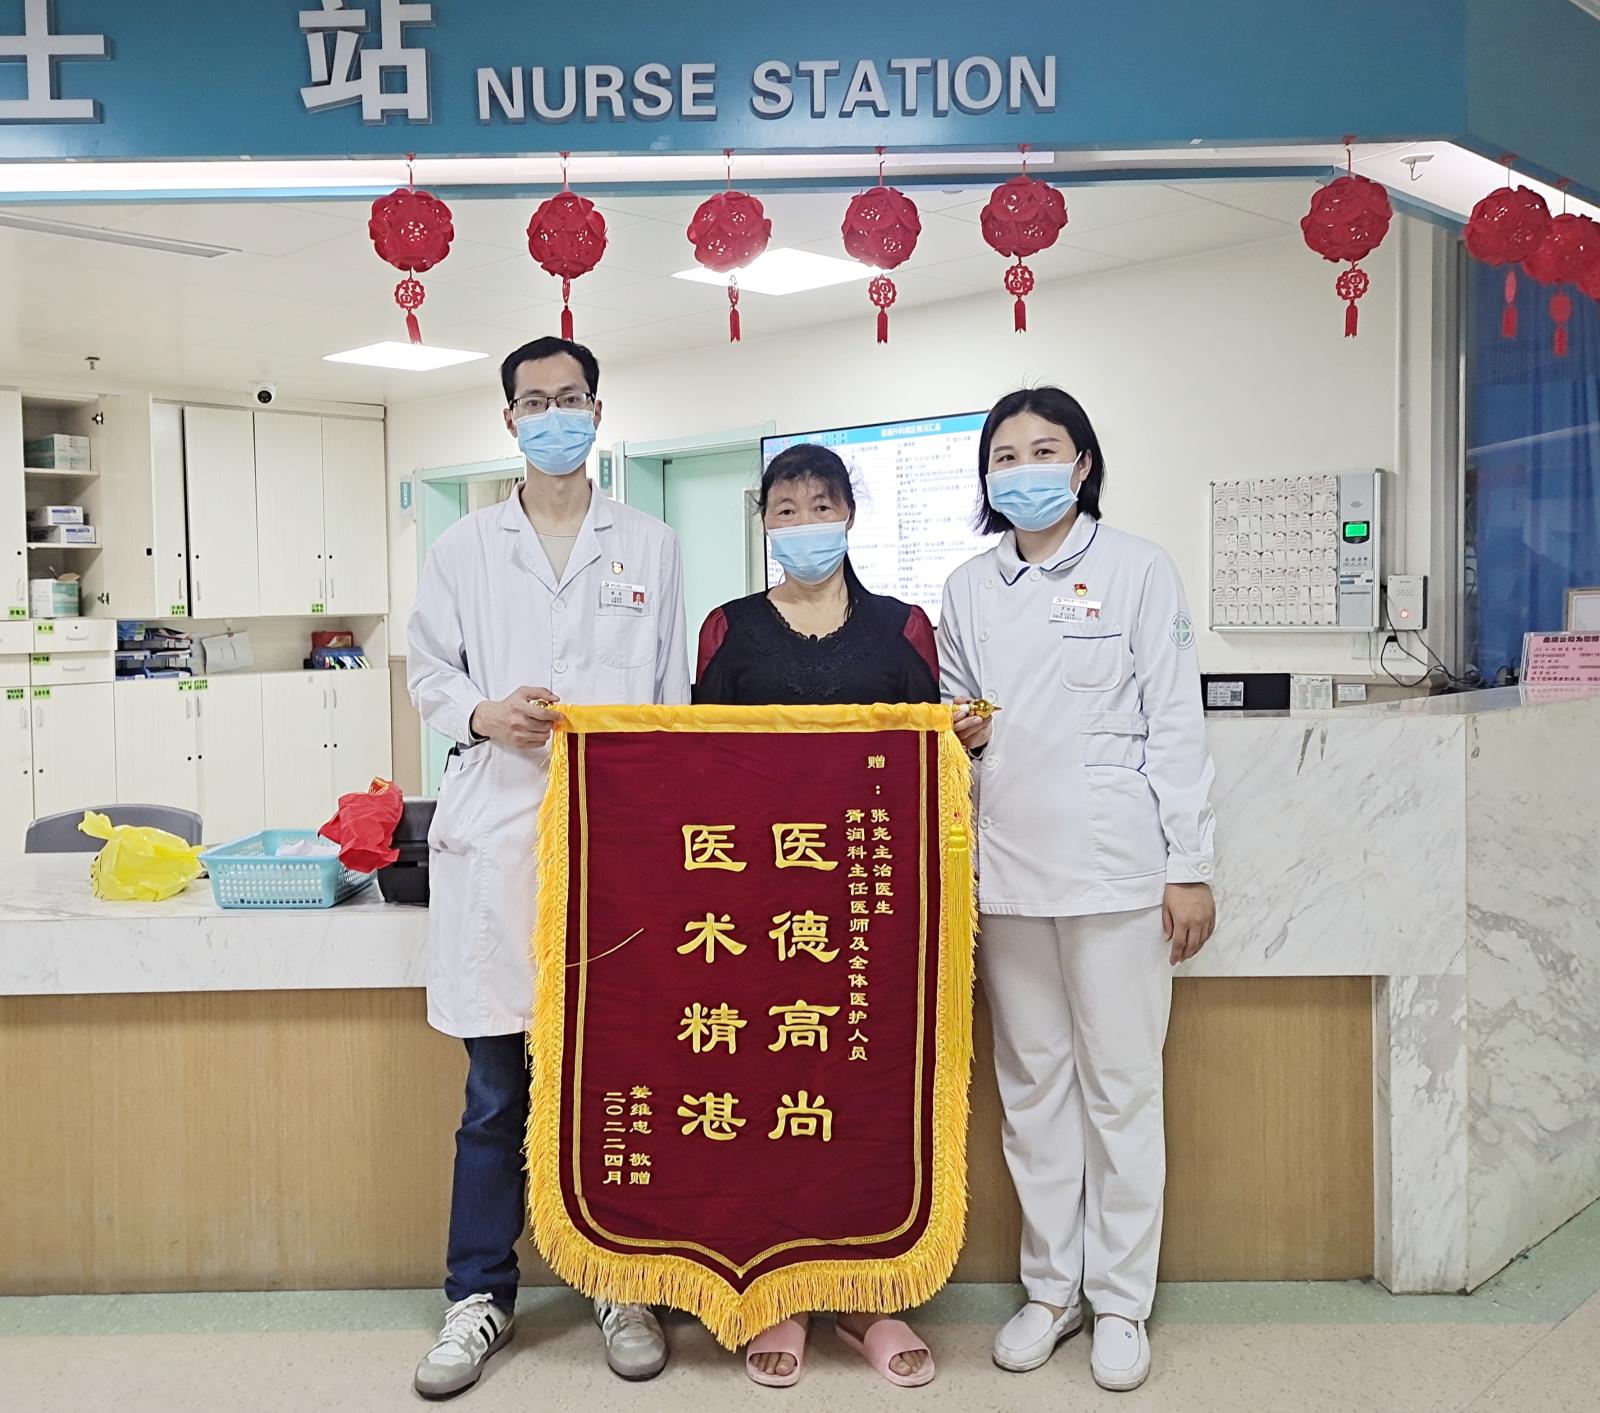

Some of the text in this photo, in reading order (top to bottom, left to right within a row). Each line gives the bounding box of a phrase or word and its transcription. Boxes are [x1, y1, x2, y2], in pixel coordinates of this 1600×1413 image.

[477, 54, 1057, 121] NURSE STATION
[676, 824, 747, 1141] 医术精湛
[768, 823, 840, 1142] 医德高尚
